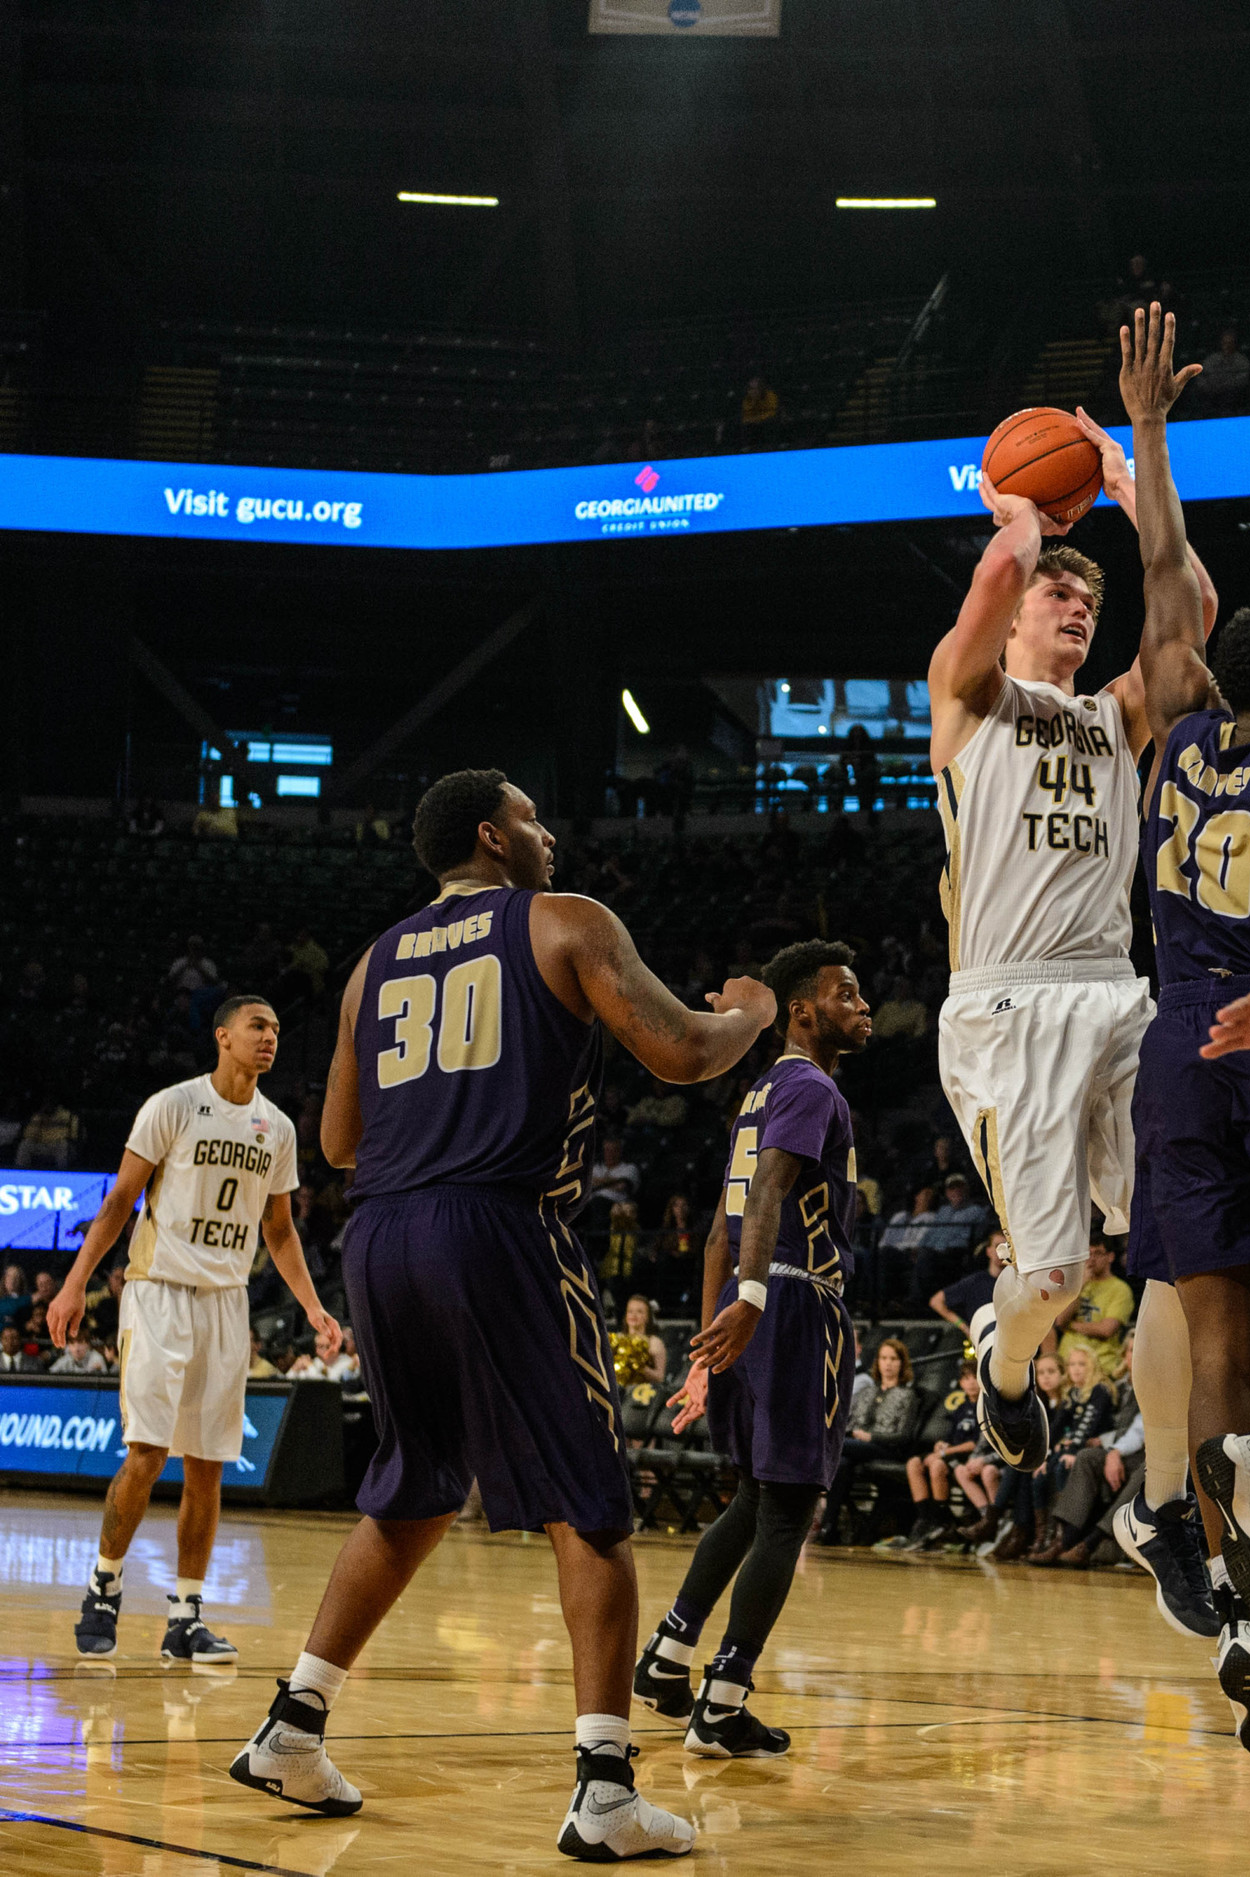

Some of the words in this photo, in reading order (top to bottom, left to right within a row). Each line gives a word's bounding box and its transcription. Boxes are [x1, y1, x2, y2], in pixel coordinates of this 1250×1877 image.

[164, 487, 229, 517] Visit
[236, 497, 363, 528] gucu.org
[1015, 710, 1114, 757] GEORGIA
[1038, 755, 1096, 807] 44
[1021, 813, 1110, 858] TECH
[395, 911, 494, 960] BRAVES
[377, 954, 503, 1090] 30
[193, 1139, 272, 1179] GEORGIA
[216, 1177, 239, 1212] 0
[190, 1218, 249, 1250] TECH
